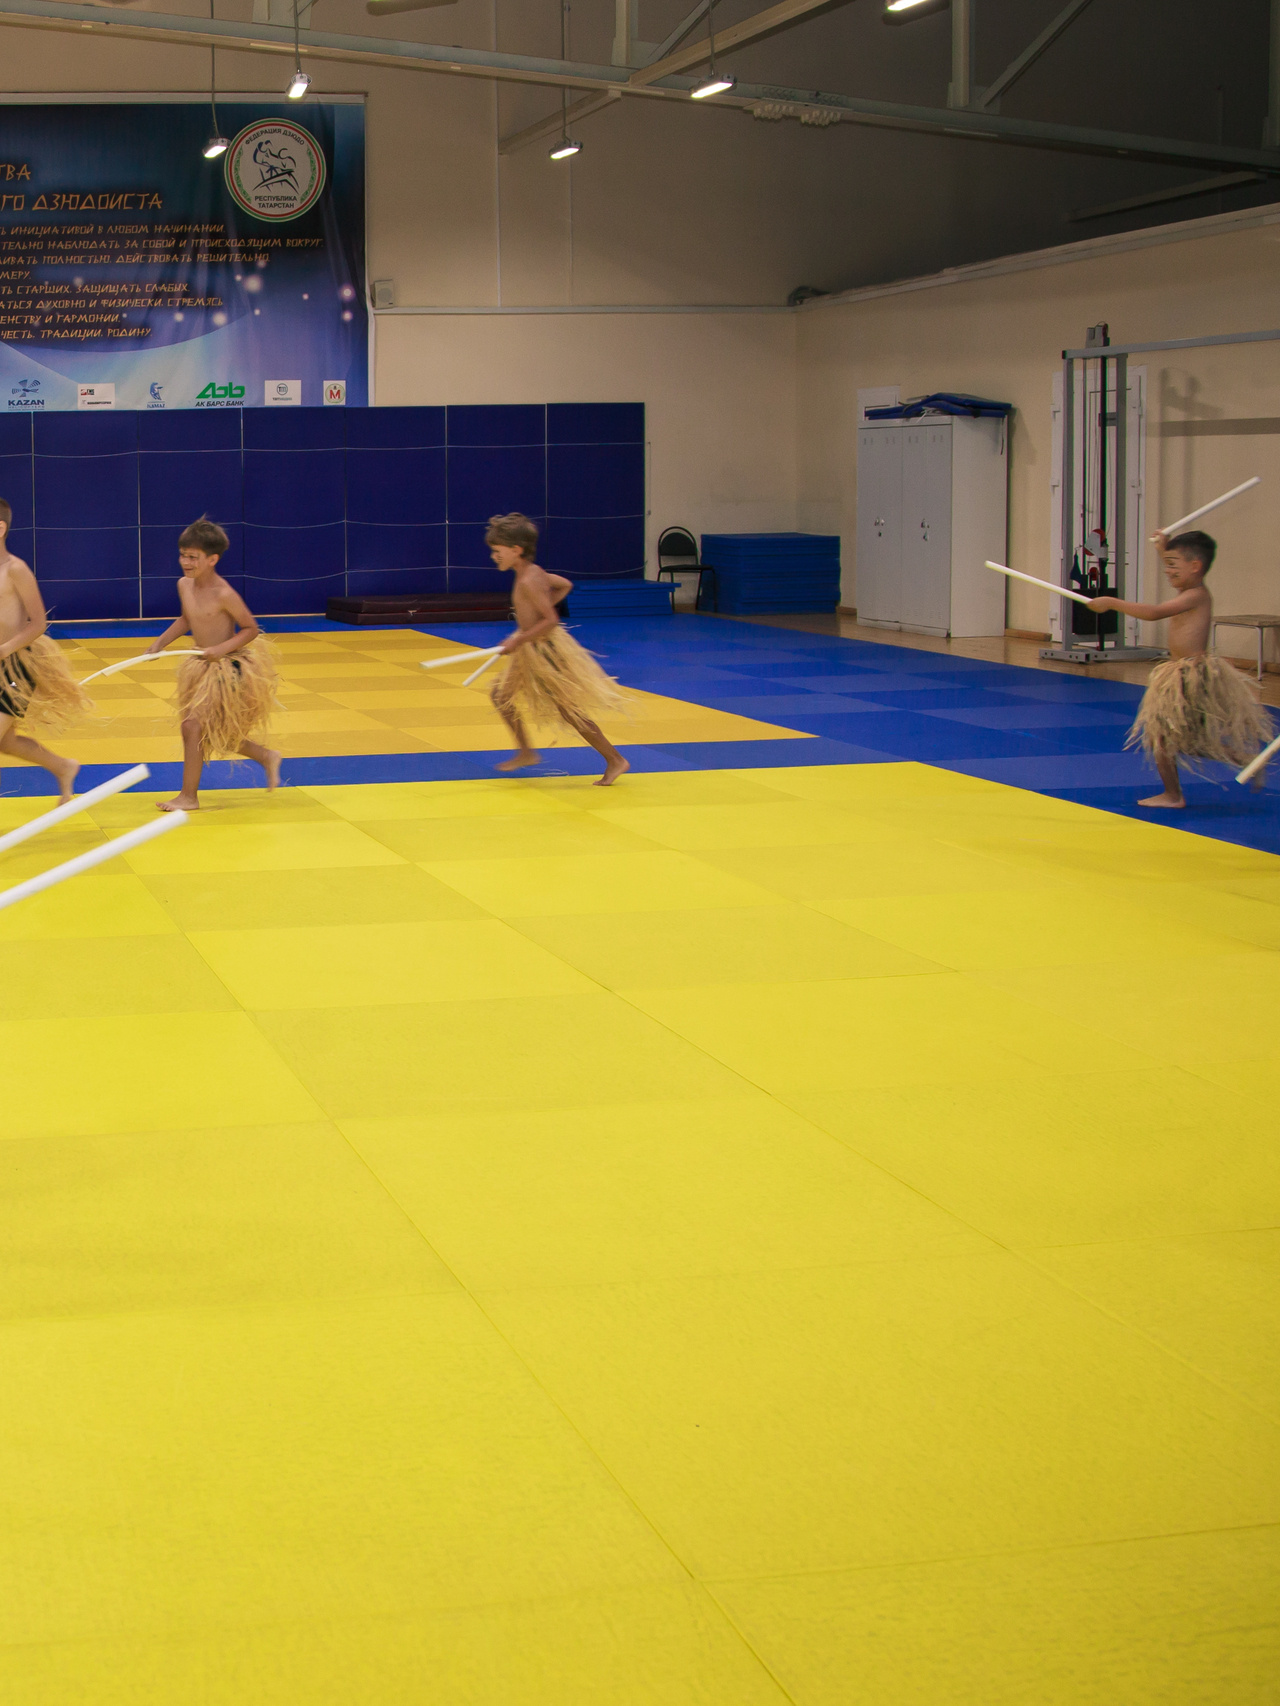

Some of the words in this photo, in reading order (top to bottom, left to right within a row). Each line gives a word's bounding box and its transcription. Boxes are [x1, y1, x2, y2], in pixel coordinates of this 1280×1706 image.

[245, 128, 282, 145] ФЕДЕРАЦИЯ
[282, 130, 305, 145] ДЗЮДО
[32, 193, 163, 211] ДЗЮДОИСТА
[10, 223, 94, 238] ИНИЦИАТИВОЙ
[97, 225, 104, 235] В
[107, 224, 149, 234] ЛЮБОМ
[48, 240, 120, 250] НАБЛЮДАТЬ
[124, 239, 139, 249] ЗА
[142, 237, 176, 248] СОБОЙ
[179, 239, 187, 248] И
[191, 238, 282, 250] ПРОИСХОДЯЩИМ
[115, 253, 192, 264] ДЕЙСТВОВАТЬ
[0, 270, 32, 280] МЕРУ.
[75, 284, 141, 296] ЗАЩИЩАТЬ
[35, 300, 86, 310] ДУХОВНО
[89, 299, 97, 308] И
[167, 298, 224, 307] СТРЕМЯСЬ
[45, 315, 53, 324] И
